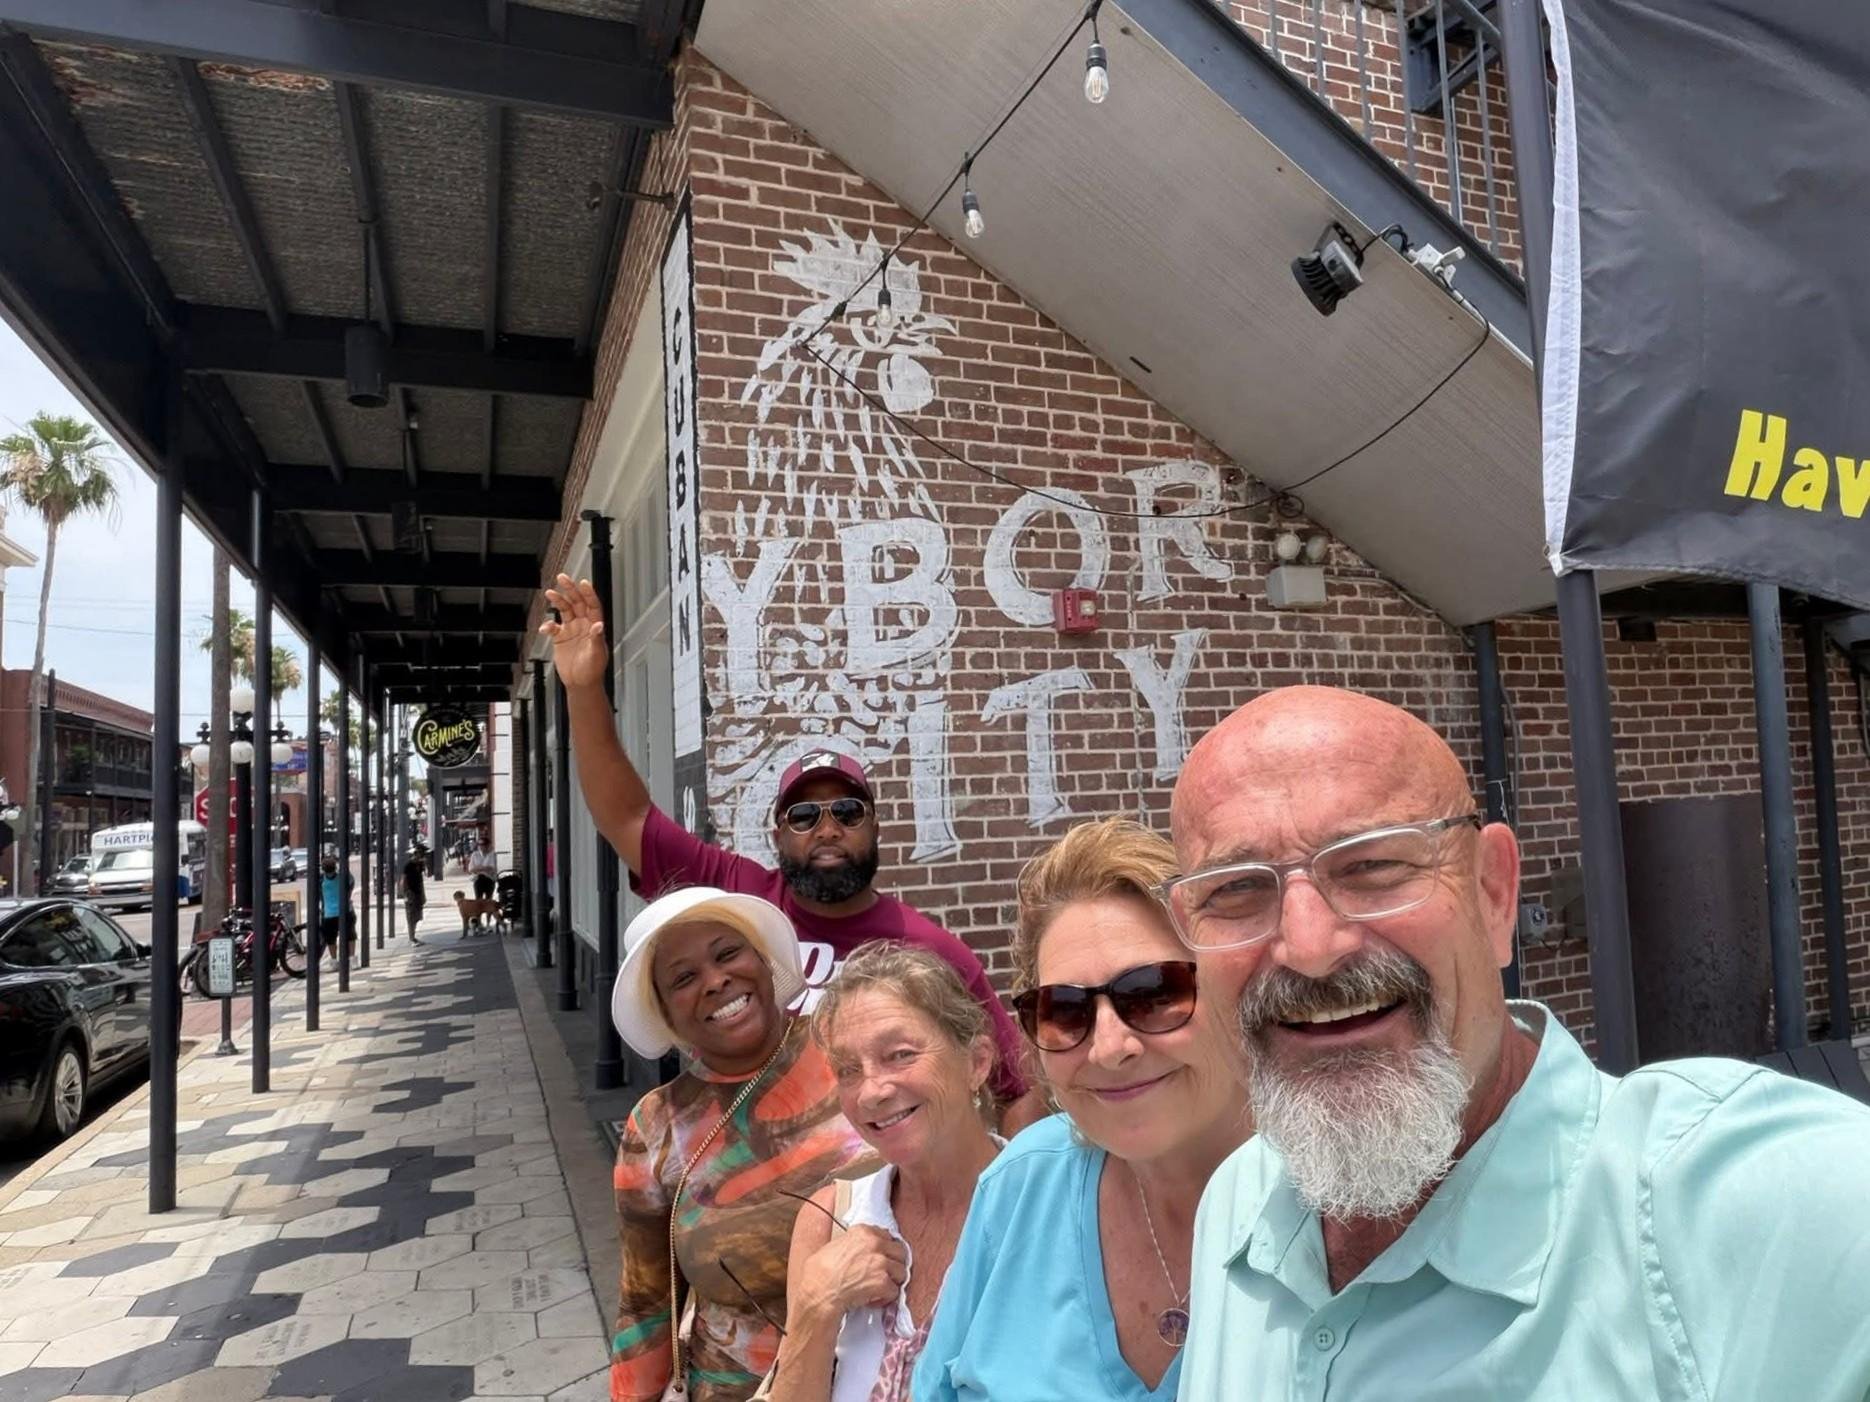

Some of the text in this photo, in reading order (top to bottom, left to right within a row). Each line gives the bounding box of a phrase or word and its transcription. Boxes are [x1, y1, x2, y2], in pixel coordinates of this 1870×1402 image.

[672, 306, 691, 657] CUBAN
[700, 459, 1234, 714] YBOR
[416, 718, 476, 756] CARMINE'S
